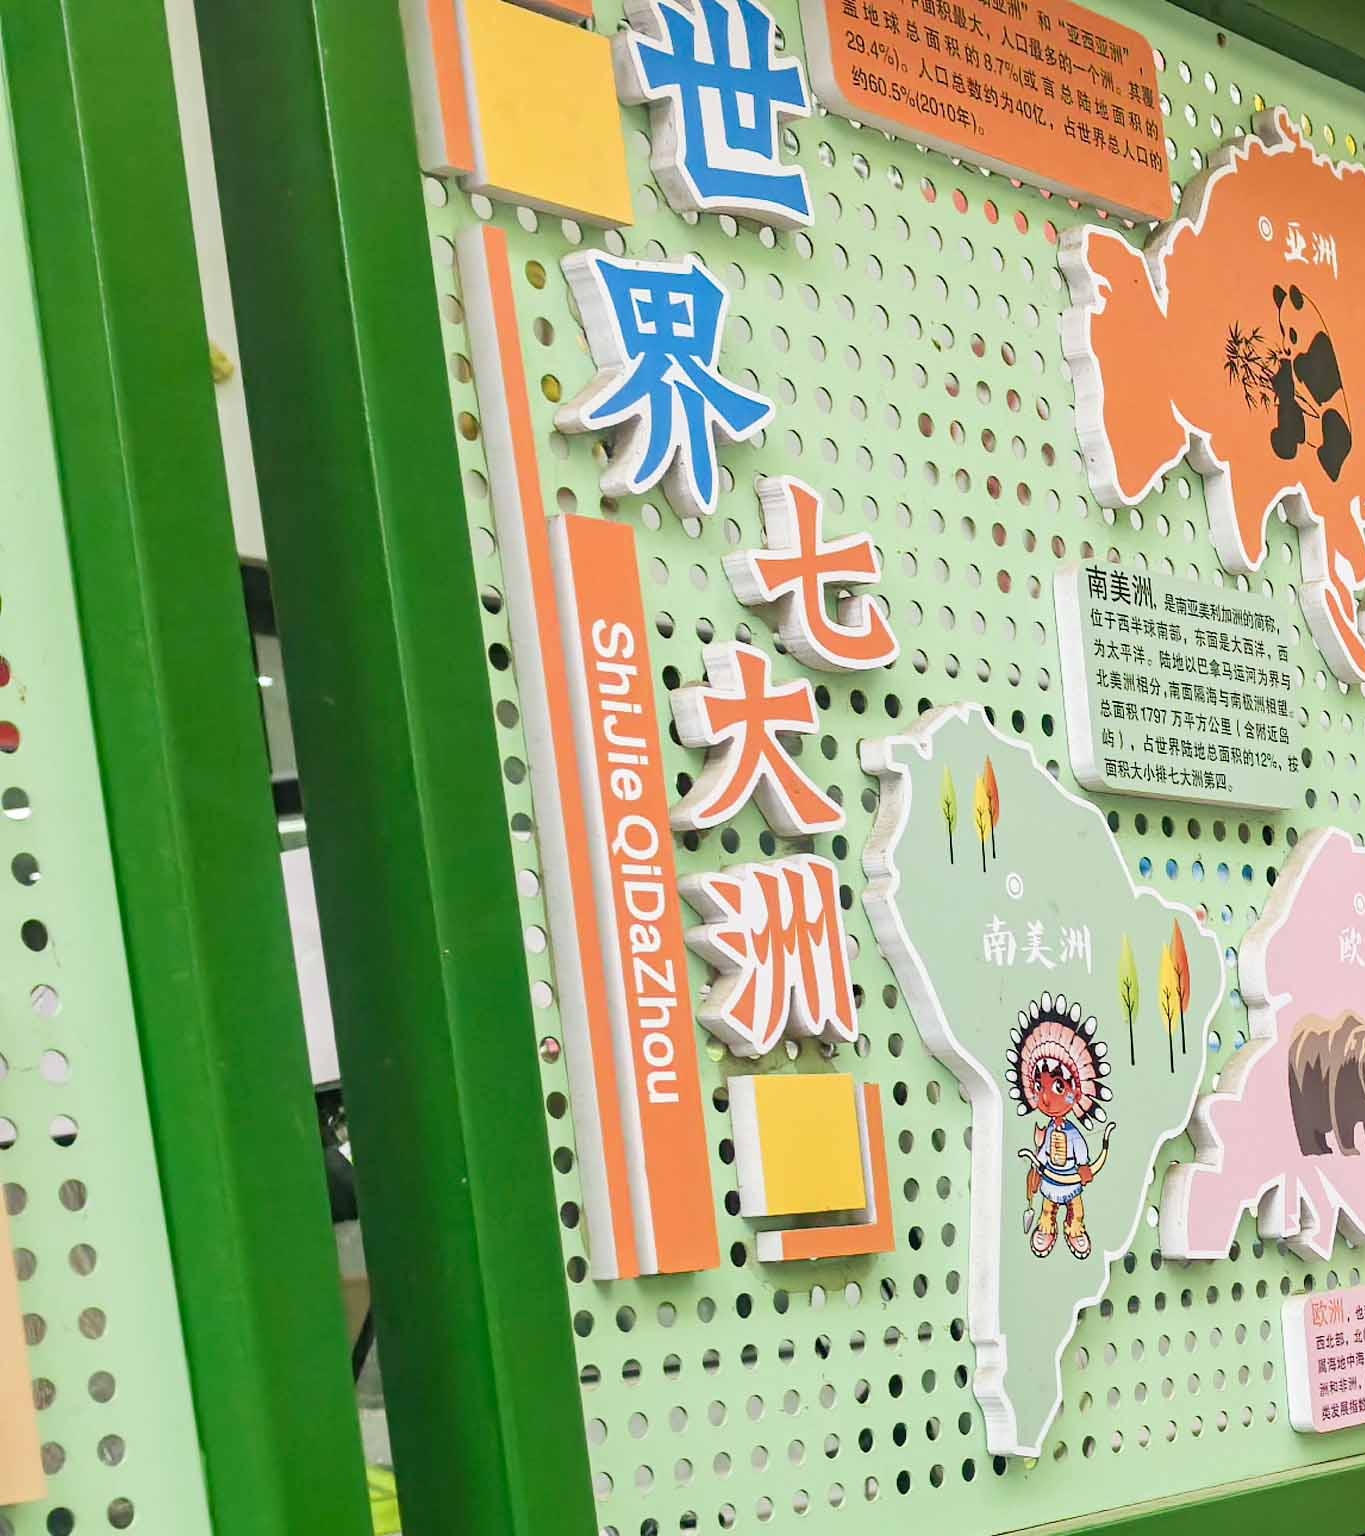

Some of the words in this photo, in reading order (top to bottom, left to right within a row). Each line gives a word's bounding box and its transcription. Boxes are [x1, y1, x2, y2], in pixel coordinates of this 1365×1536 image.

[851, 65, 986, 137] 约60.5%(2010年)。
[1284, 221, 1339, 280] 亚洲
[592, 619, 645, 801] ShiJie
[1104, 757, 1233, 792] 面积大小排七大洲第四。
[610, 815, 680, 1105] QiDaZhou
[982, 913, 1093, 974] 南美洲
